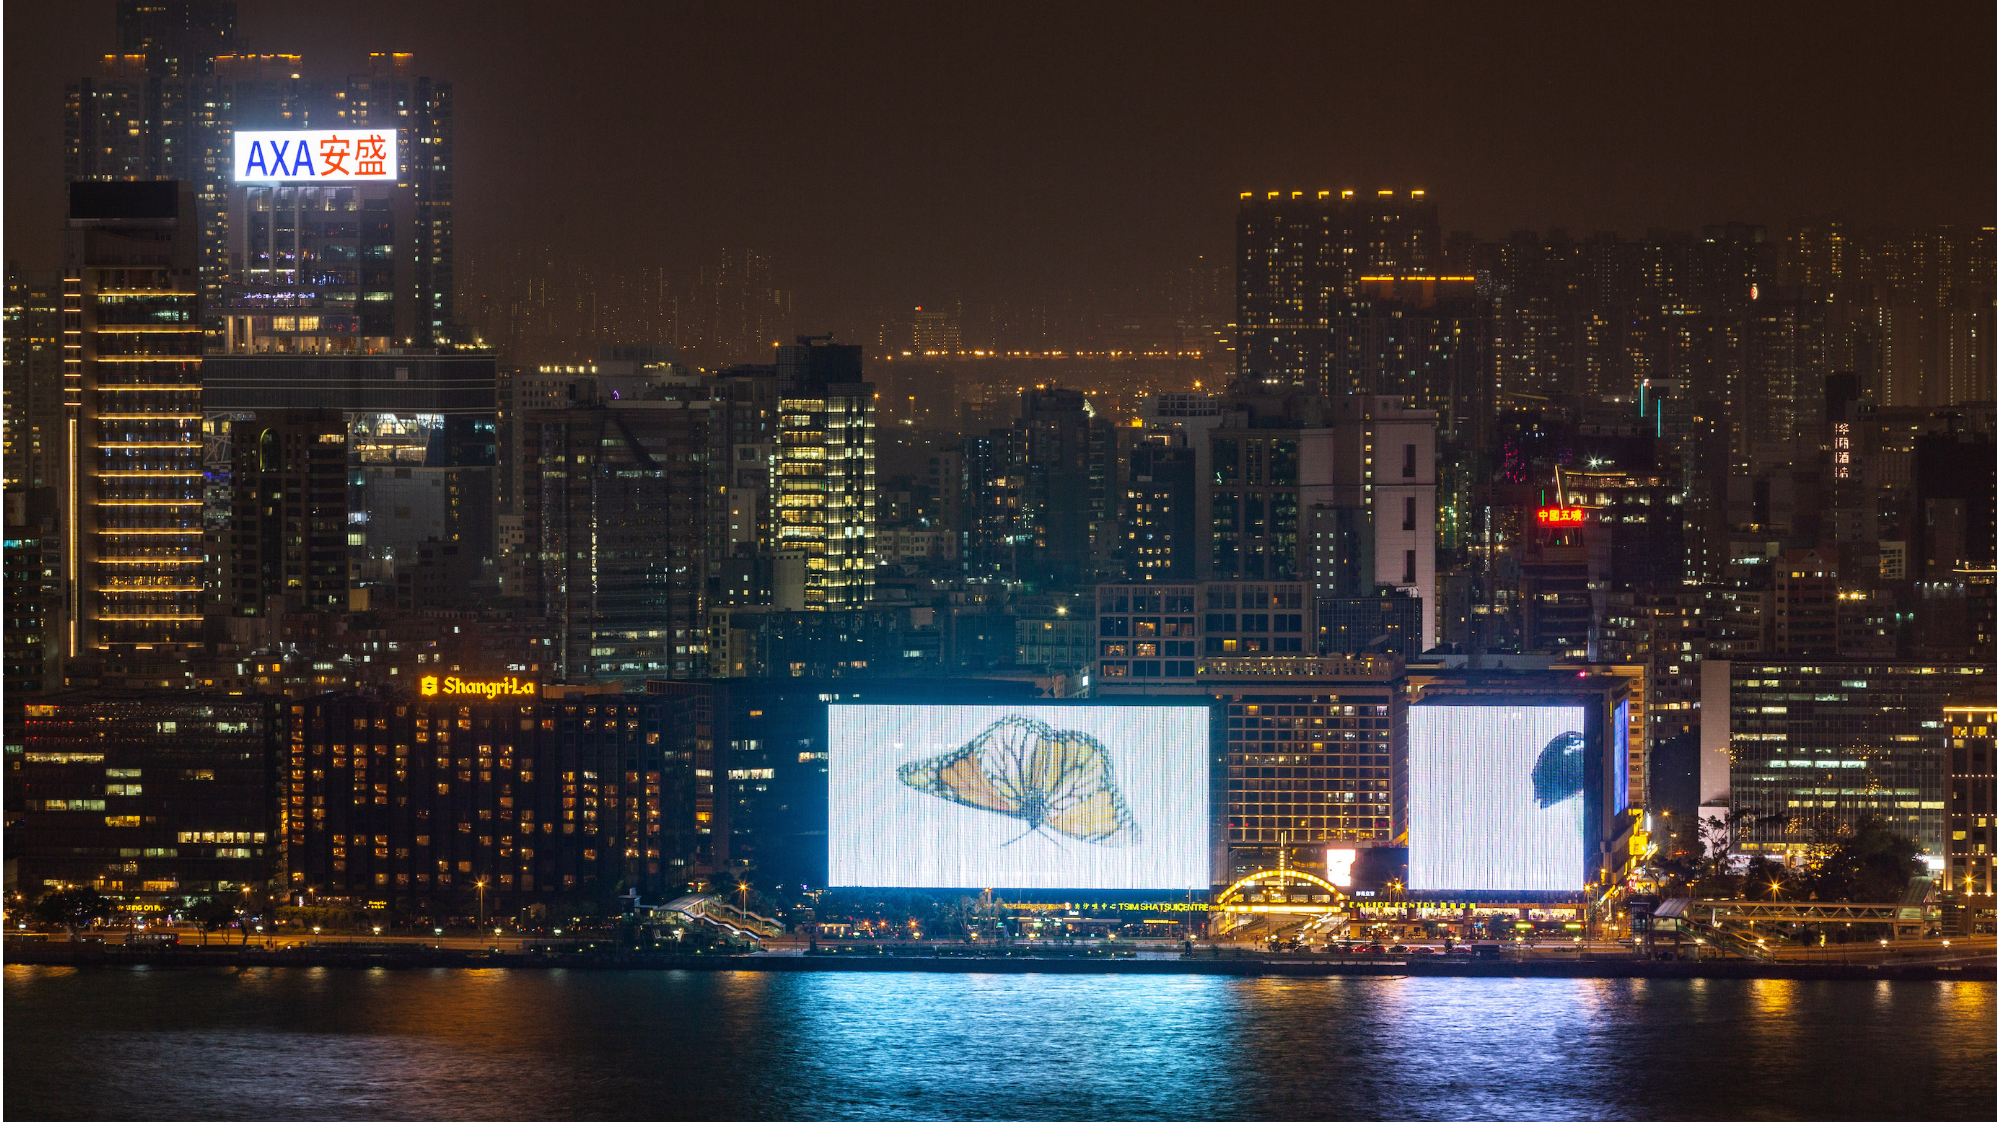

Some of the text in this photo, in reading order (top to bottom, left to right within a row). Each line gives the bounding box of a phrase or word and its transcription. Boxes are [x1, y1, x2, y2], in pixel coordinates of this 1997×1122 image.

[245, 134, 386, 176] AXA 安盛
[442, 676, 535, 700] Shangri-La
[1140, 903, 1158, 911] SHA
